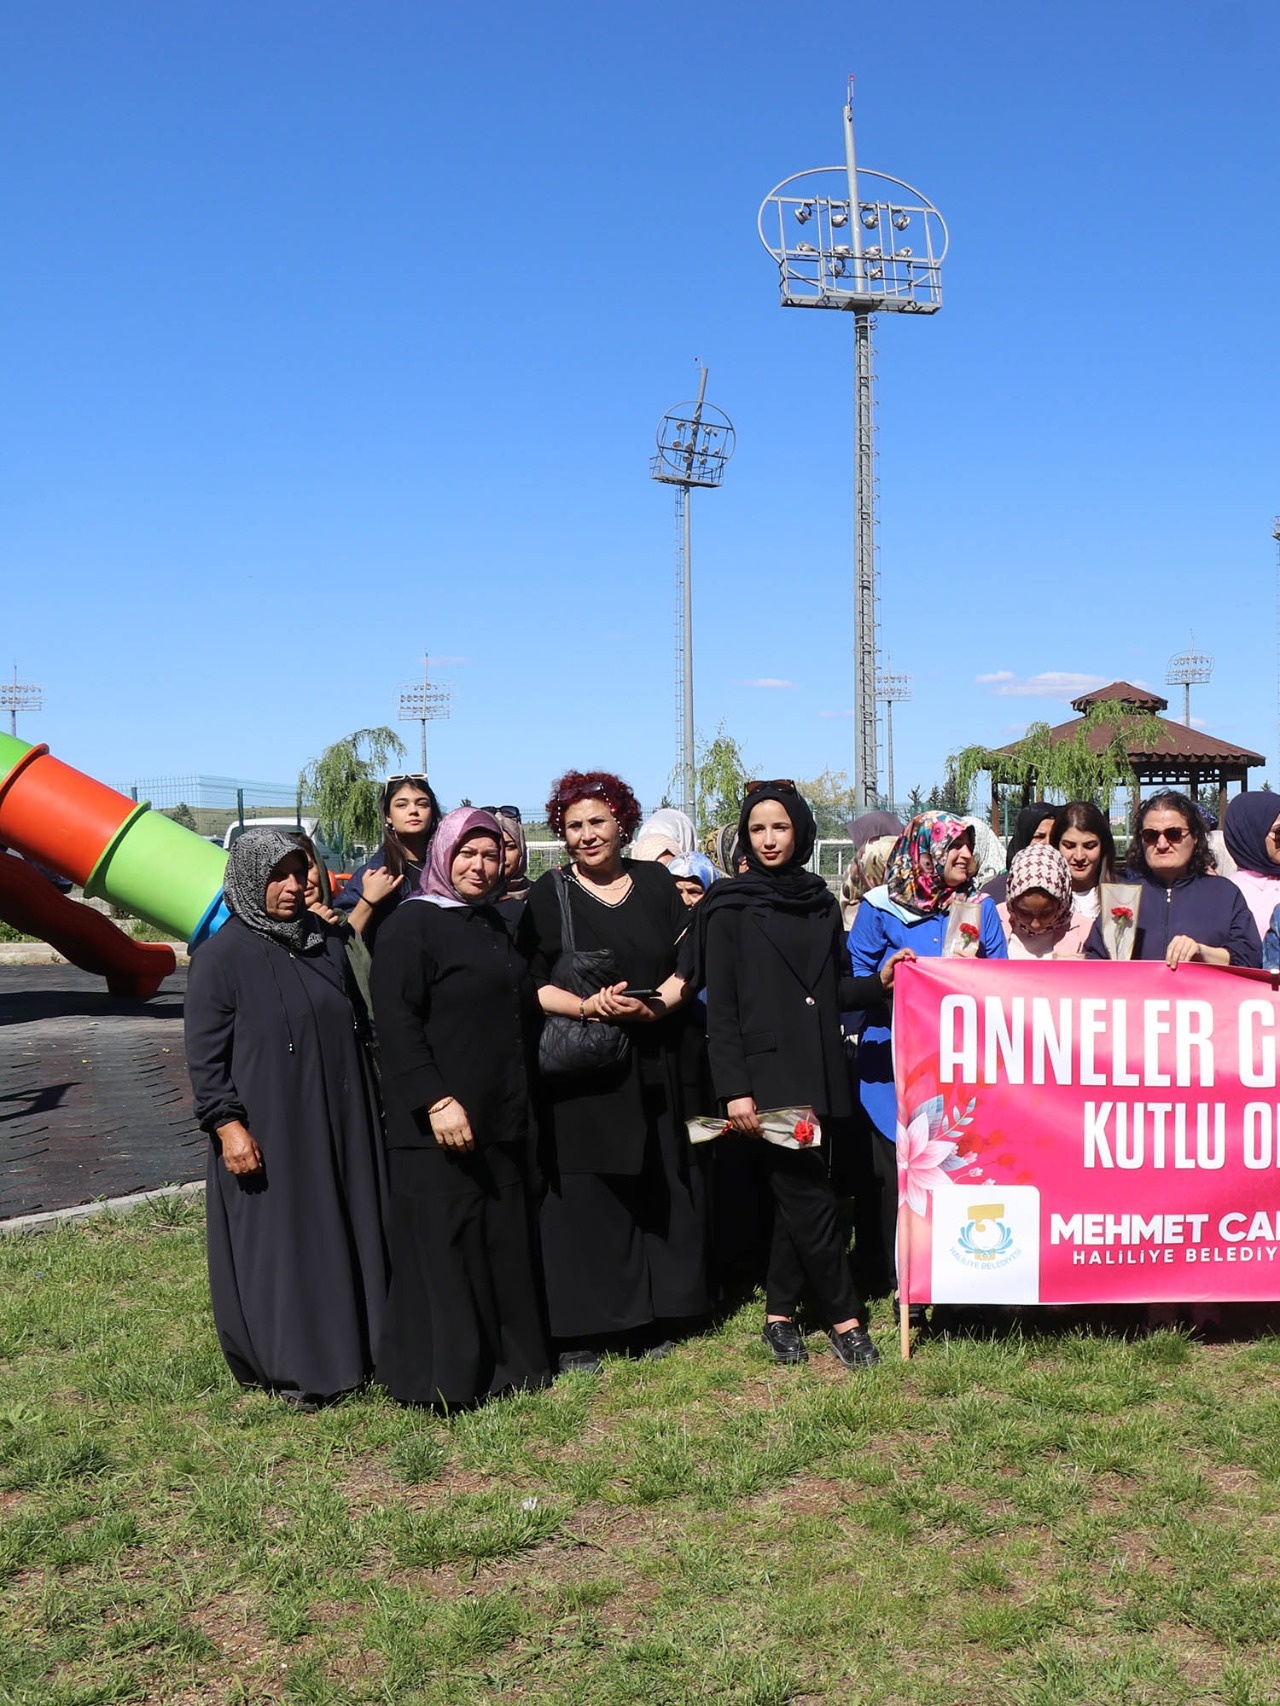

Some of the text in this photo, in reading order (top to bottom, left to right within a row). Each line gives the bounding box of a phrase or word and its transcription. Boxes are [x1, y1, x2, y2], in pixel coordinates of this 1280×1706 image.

[939, 994, 1215, 1087] ANNELER
[1083, 1101, 1226, 1170] KUTLU
[1050, 1213, 1209, 1245] MEHMET
